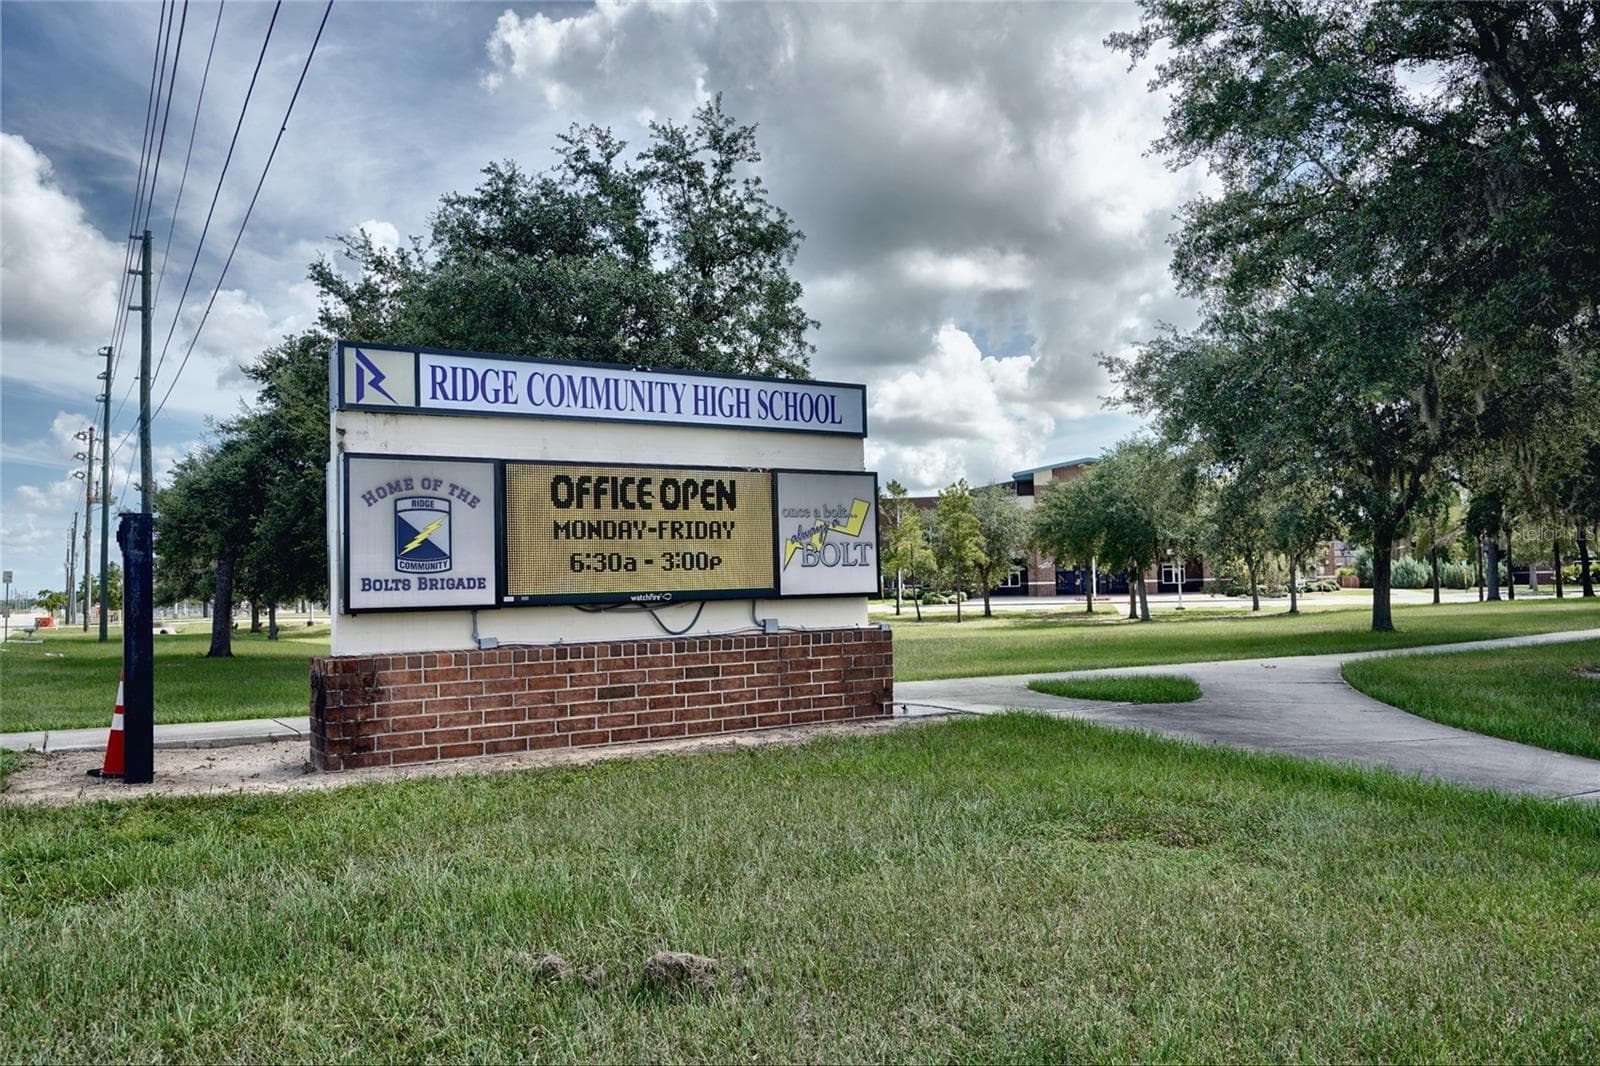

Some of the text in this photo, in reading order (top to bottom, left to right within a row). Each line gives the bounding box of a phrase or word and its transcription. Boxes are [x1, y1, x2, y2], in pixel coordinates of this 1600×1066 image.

[429, 364, 843, 425] RIDGE COMMUNITY HIGH SCHOOL
[361, 478, 480, 509] HOME OF THE
[411, 499, 435, 509] RIDGE
[550, 474, 737, 512] OFFICE OPEN
[782, 508, 811, 519] once
[814, 508, 821, 519] a
[553, 519, 736, 541] MONDAY-FRIDAY
[790, 519, 840, 544] always a
[399, 560, 449, 571] COMMUNITY
[569, 552, 637, 573] 6:30a
[660, 551, 722, 572] 3:00p
[800, 541, 873, 568] BOLT
[360, 576, 487, 592] BOLTS BRIGADE
